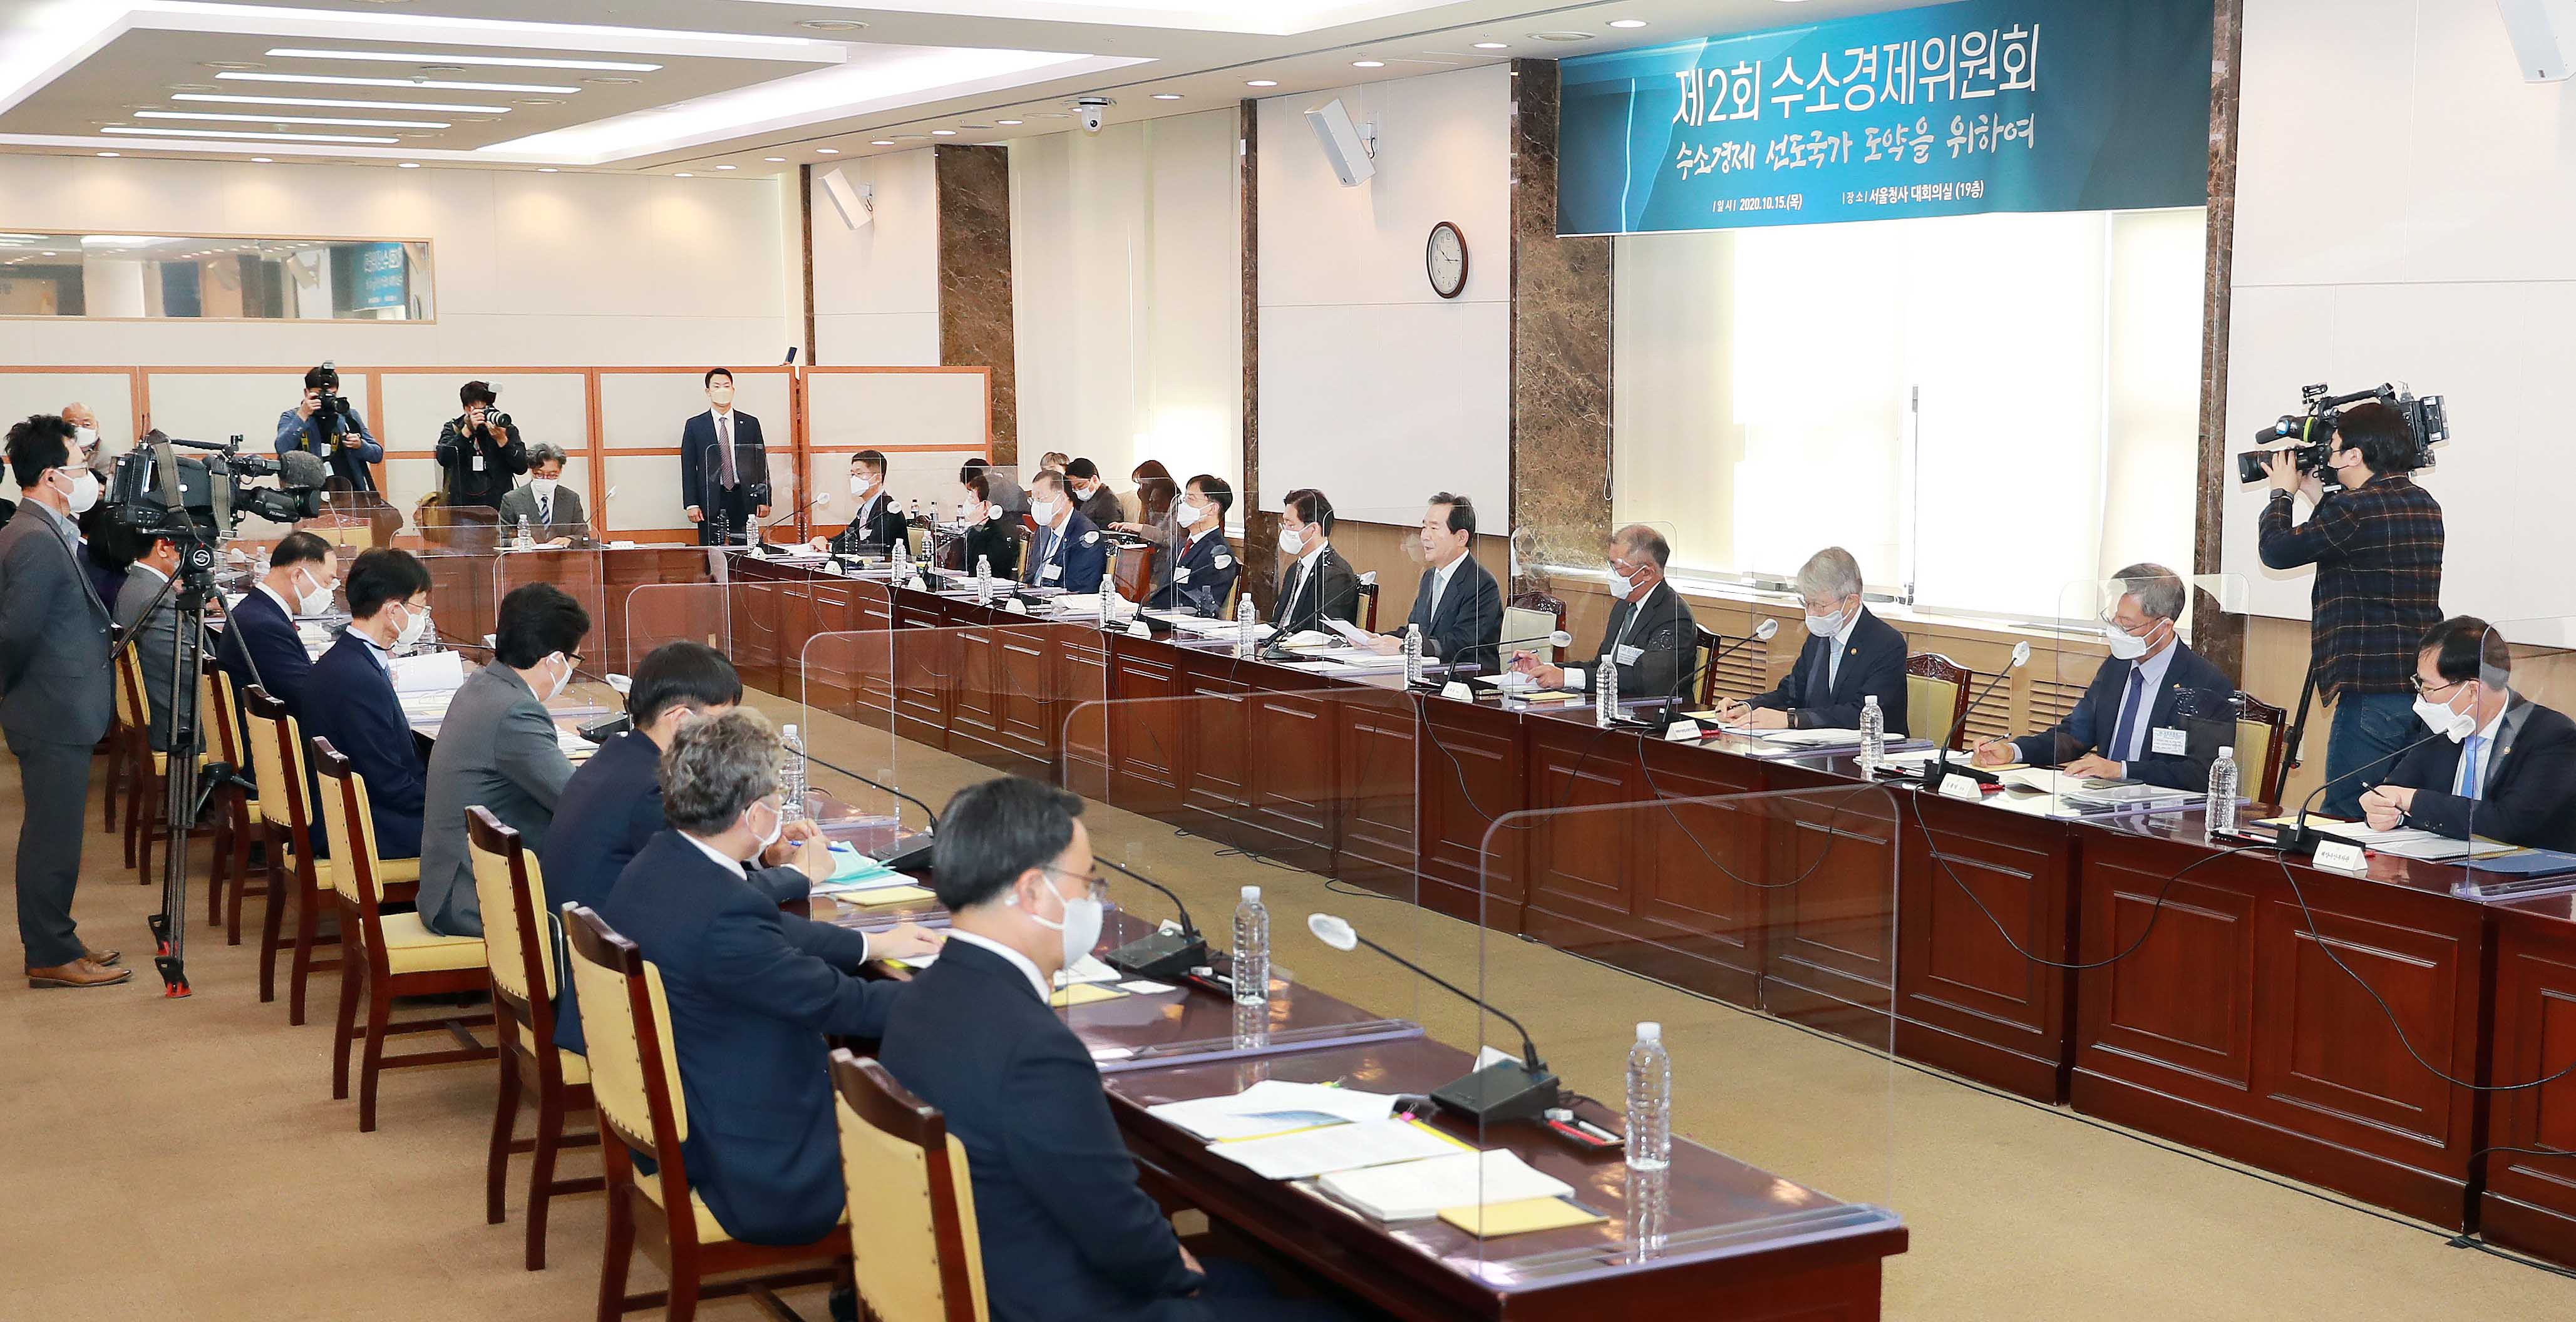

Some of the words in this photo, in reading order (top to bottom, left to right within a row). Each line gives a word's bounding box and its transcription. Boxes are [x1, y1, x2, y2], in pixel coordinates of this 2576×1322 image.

[1672, 59, 1761, 126] 제2회
[1770, 23, 2039, 119] 수소경제위원회
[1676, 140, 1756, 181] 수소경제
[1765, 130, 1853, 172] 선도국가
[1864, 116, 1934, 164] 도약을
[1946, 112, 2035, 158] 위하여
[1739, 193, 1803, 211] 2020.10.15.(목)
[1869, 185, 1909, 205] 서울청사
[1911, 183, 1952, 202] 대회의실
[1955, 180, 1984, 200] (19층)
